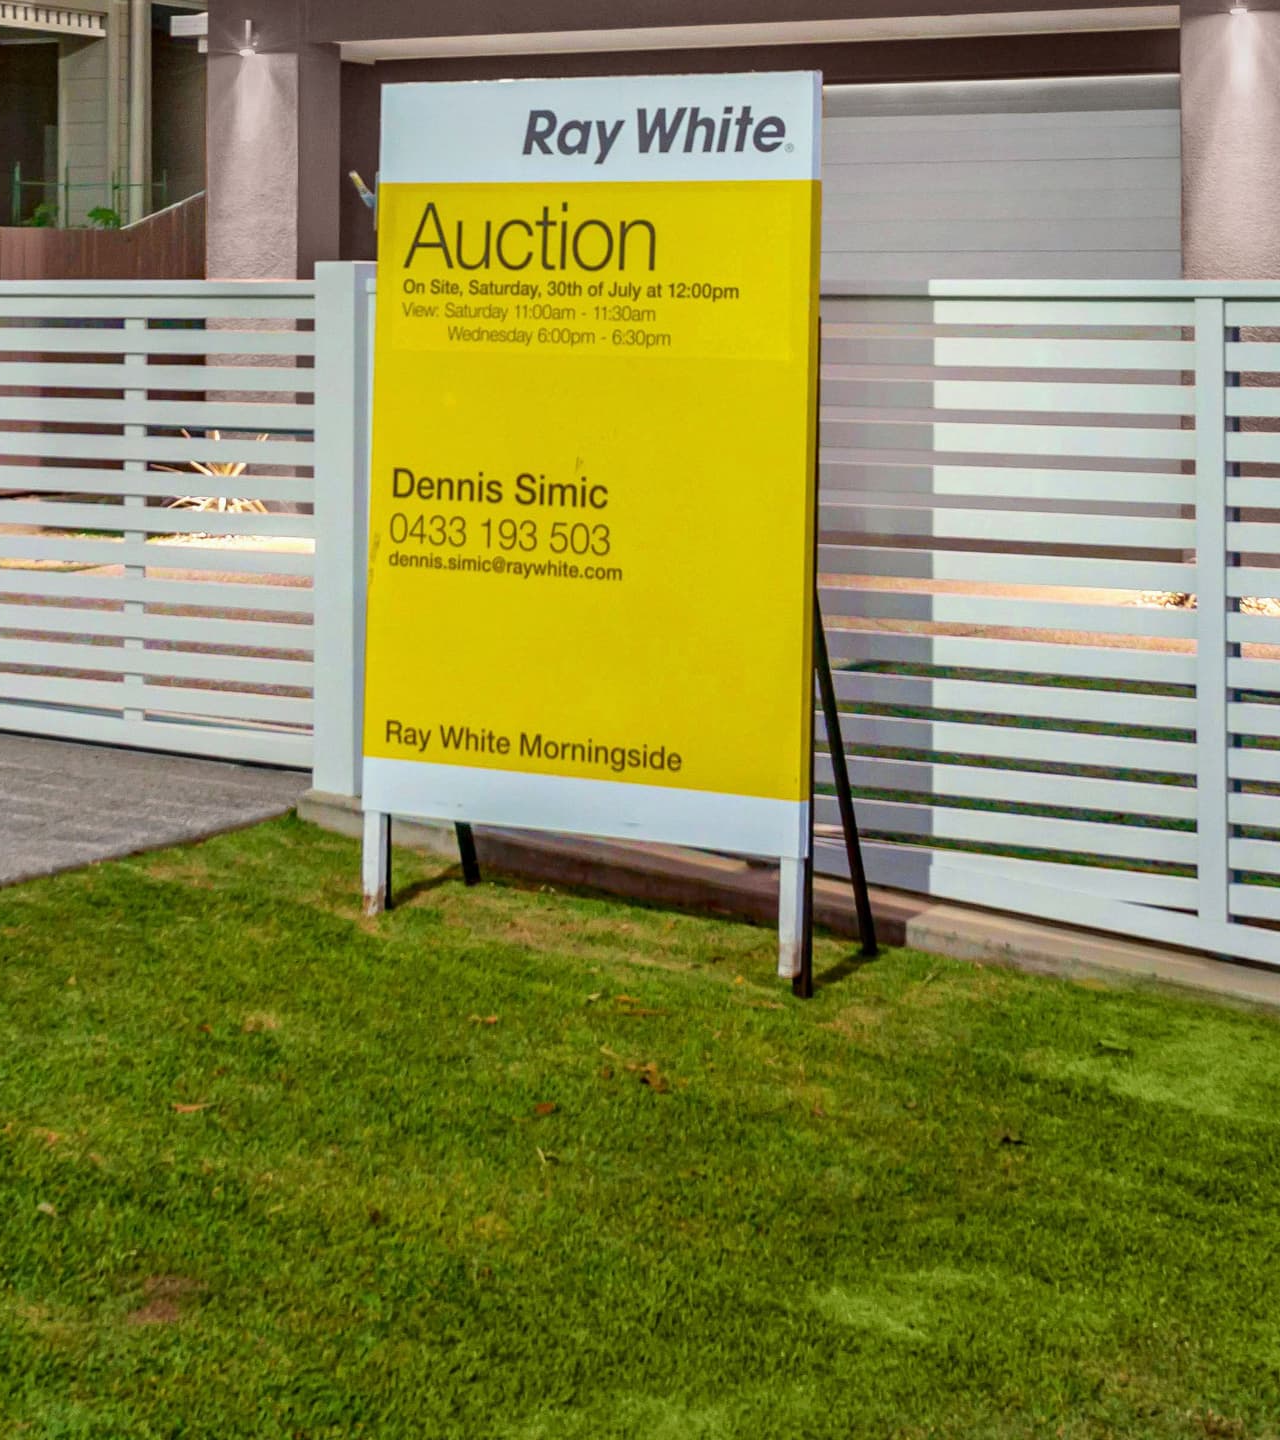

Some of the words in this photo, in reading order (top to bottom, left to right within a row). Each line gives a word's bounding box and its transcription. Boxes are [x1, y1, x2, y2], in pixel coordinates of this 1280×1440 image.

[523, 109, 624, 164] Ray
[637, 106, 786, 153] White
[403, 202, 656, 271] Auction
[403, 279, 425, 295] On
[430, 280, 463, 298] Site,
[468, 281, 542, 300] Saturday,
[547, 281, 582, 297] 30th
[587, 282, 603, 297] of
[607, 283, 642, 301] July
[646, 284, 663, 298] at
[669, 283, 740, 300] 12:00pm
[402, 302, 439, 318] View:
[444, 304, 508, 322] Saturday
[514, 304, 577, 320] 11:00am
[594, 306, 656, 322] 11:30am
[448, 326, 533, 345] Wednesday
[538, 327, 596, 346] 6:00pm
[612, 329, 672, 347] 6:30pm
[392, 468, 503, 504] Dennis
[514, 473, 609, 509] Simic
[390, 513, 468, 547] 0433
[480, 518, 538, 551] 193
[549, 522, 611, 556] 503
[389, 552, 623, 581] dennis.simic@raywhite.com
[385, 720, 432, 753] Ray
[440, 725, 511, 755] White
[519, 733, 682, 773] Morningside
